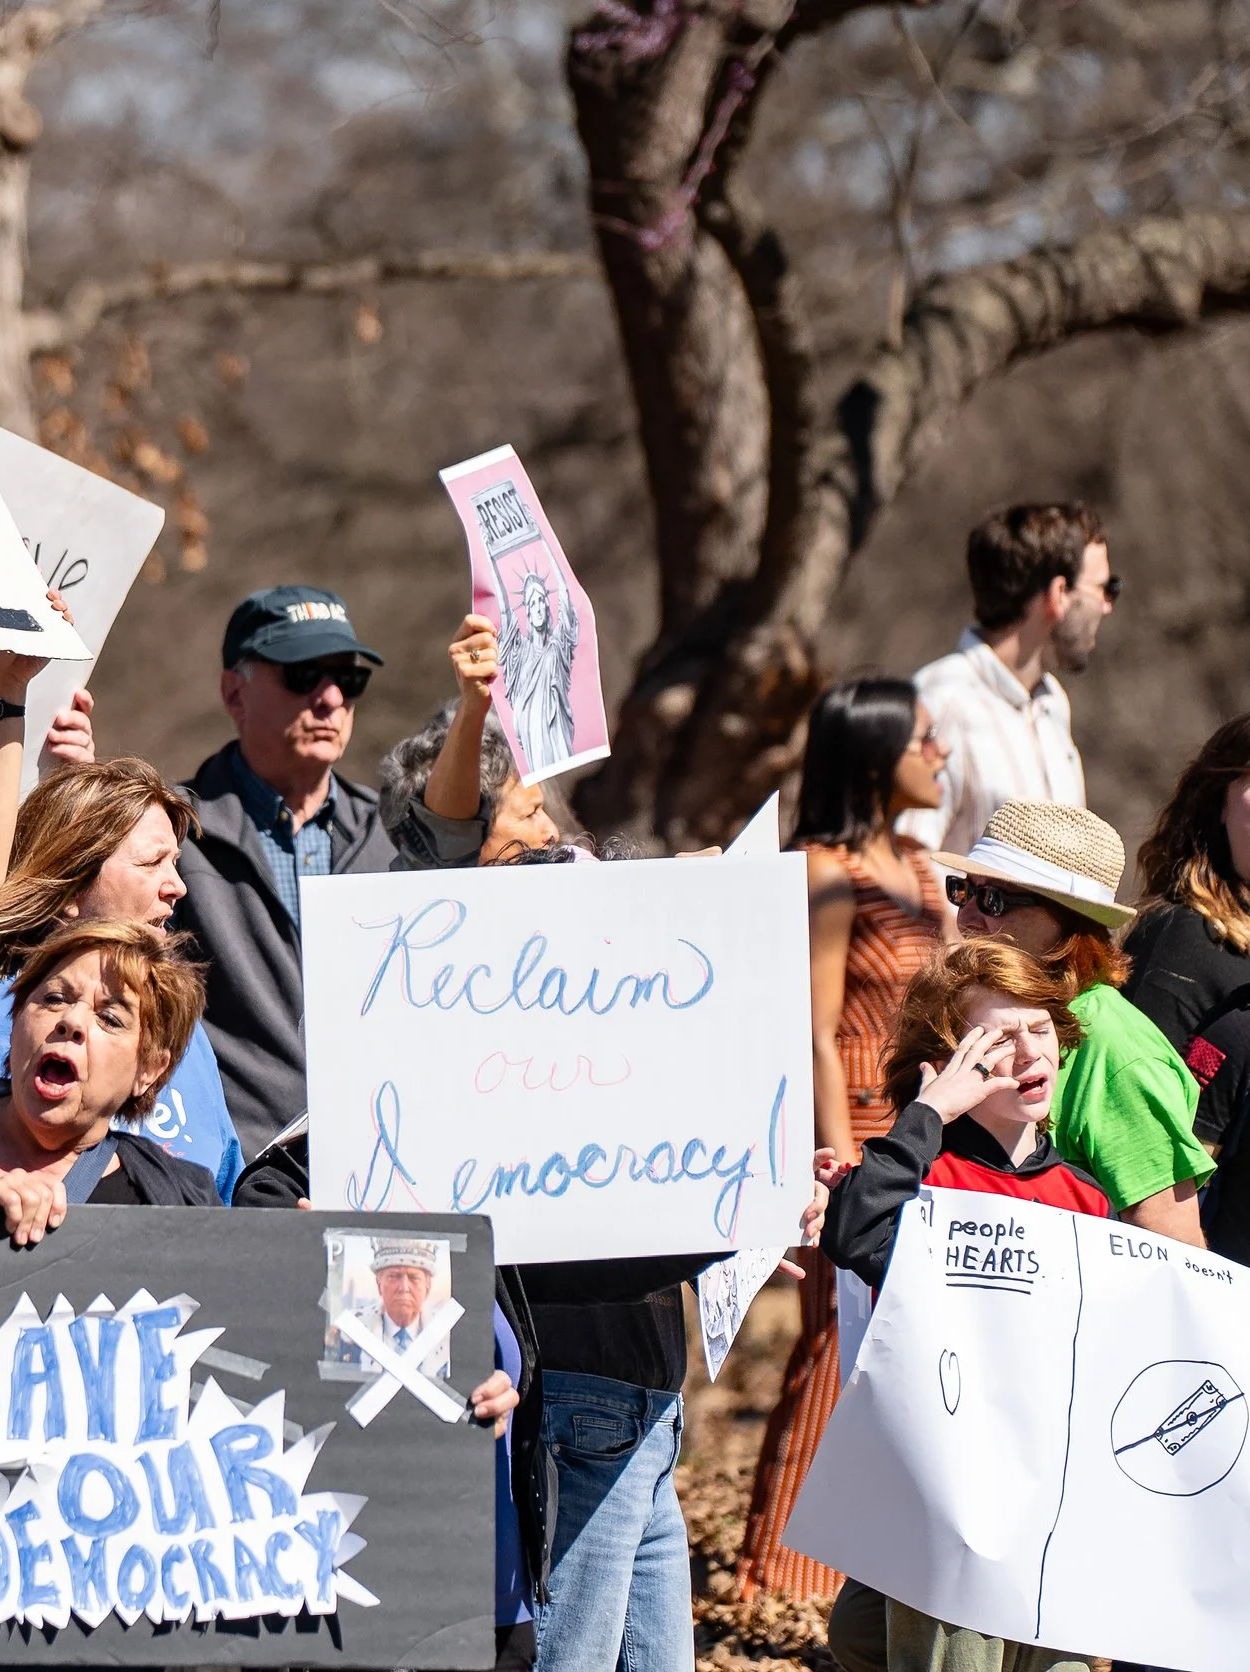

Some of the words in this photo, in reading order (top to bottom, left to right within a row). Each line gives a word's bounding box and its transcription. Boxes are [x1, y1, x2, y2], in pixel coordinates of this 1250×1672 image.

[477, 488, 529, 542] RESIST
[352, 899, 714, 1018] Reclaim
[475, 1052, 631, 1094] our
[948, 1217, 1025, 1246] people
[1109, 1233, 1168, 1261] ELON
[946, 1245, 1040, 1274] HEARTS
[57, 1424, 299, 1537] OUR
